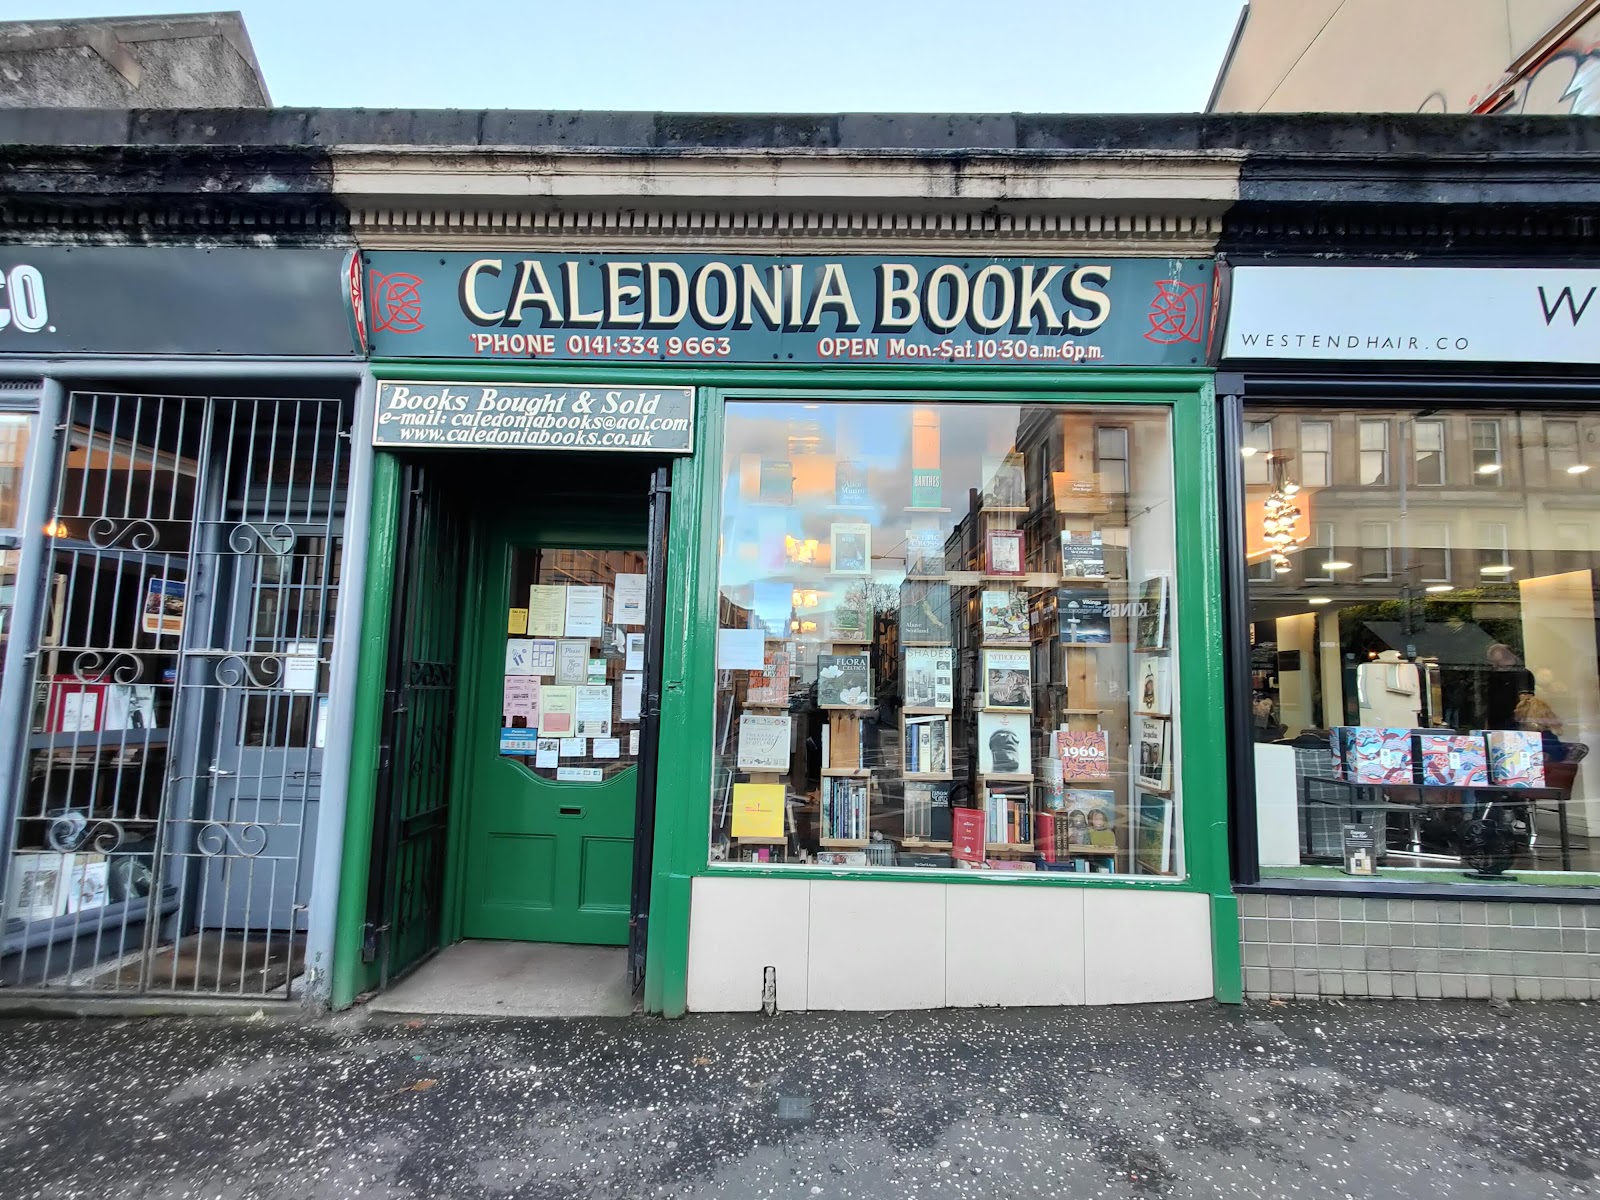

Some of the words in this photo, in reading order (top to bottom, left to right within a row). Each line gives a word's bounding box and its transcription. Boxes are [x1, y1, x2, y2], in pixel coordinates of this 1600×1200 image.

[459, 259, 861, 333] CALEDONIA
[872, 263, 1111, 336] BOOKS
[666, 337, 731, 357] 9663
[817, 337, 879, 358] OPEN
[387, 386, 470, 411] Books
[476, 388, 567, 416] Bought
[571, 391, 597, 413] &
[600, 391, 662, 414] Sold
[379, 410, 447, 426] e-mail:
[451, 409, 688, 431] caledoniabooks@aol.com
[400, 426, 655, 446] www.caledoniabooks.co.uk
[914, 475, 940, 487] BARTHES
[836, 658, 866, 666] FLORA
[907, 649, 951, 658] SHADES
[1062, 746, 1105, 758] 1960s
